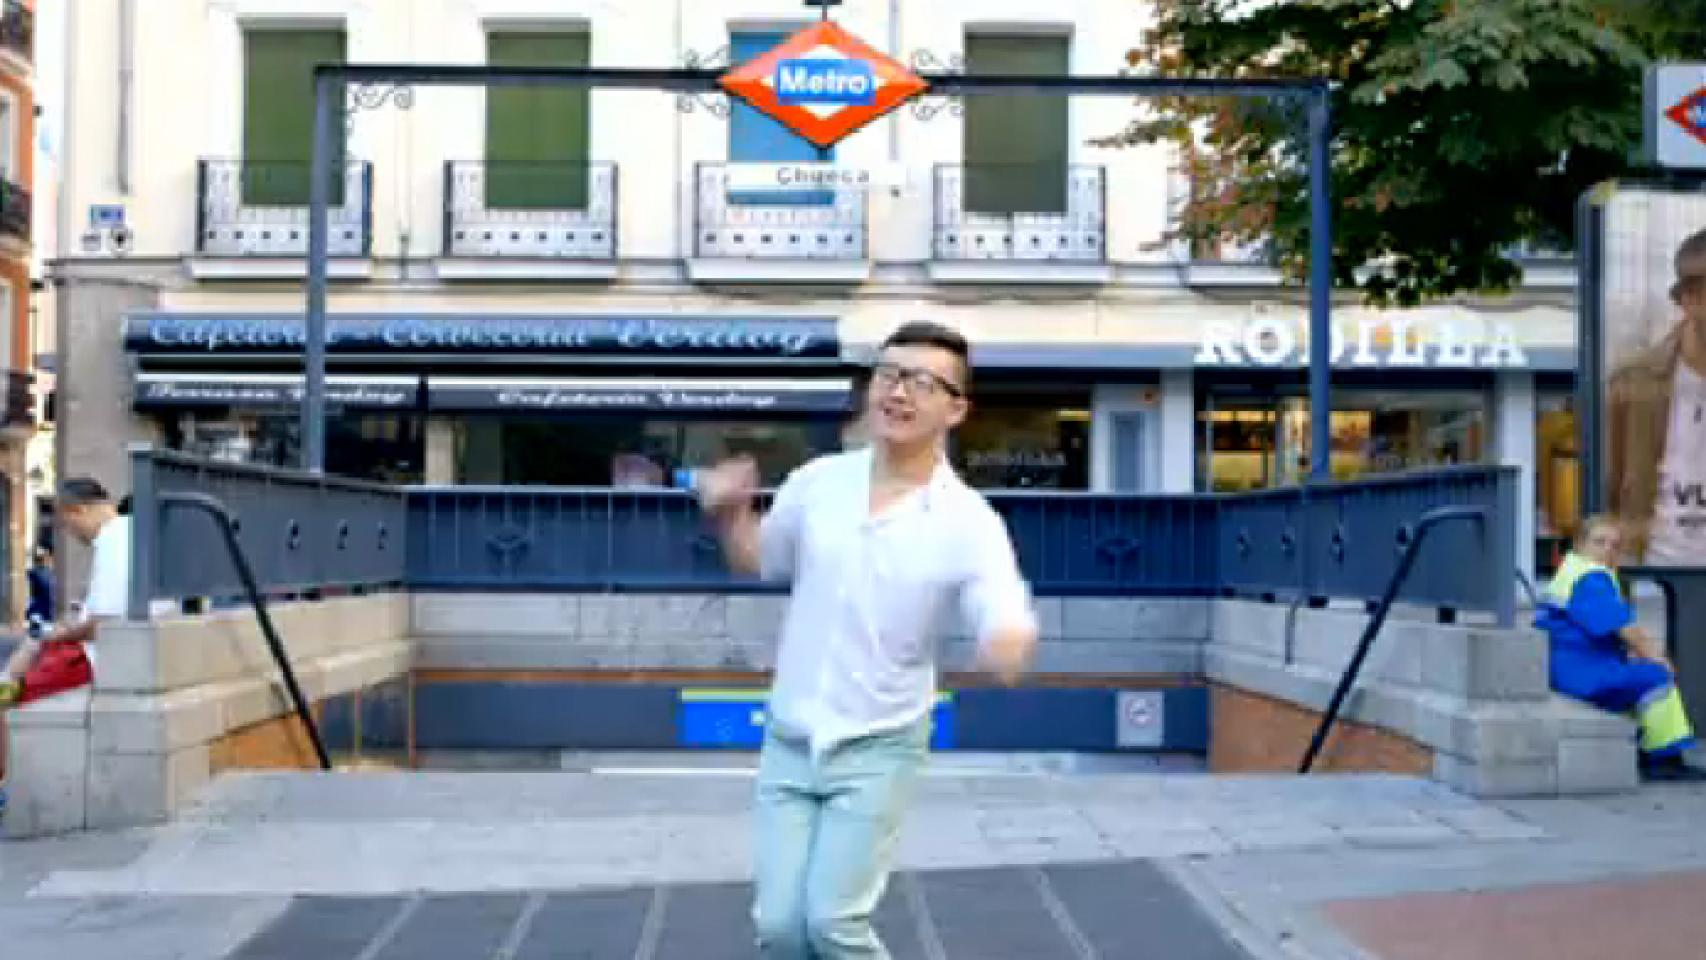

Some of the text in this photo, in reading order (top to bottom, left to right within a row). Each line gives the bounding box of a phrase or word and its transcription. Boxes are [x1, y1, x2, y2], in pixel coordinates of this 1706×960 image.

[779, 65, 867, 95] Metro
[148, 316, 341, 351] Cafeter
[1194, 316, 1528, 366] RODILLA
[286, 384, 406, 406] Vrdoy
